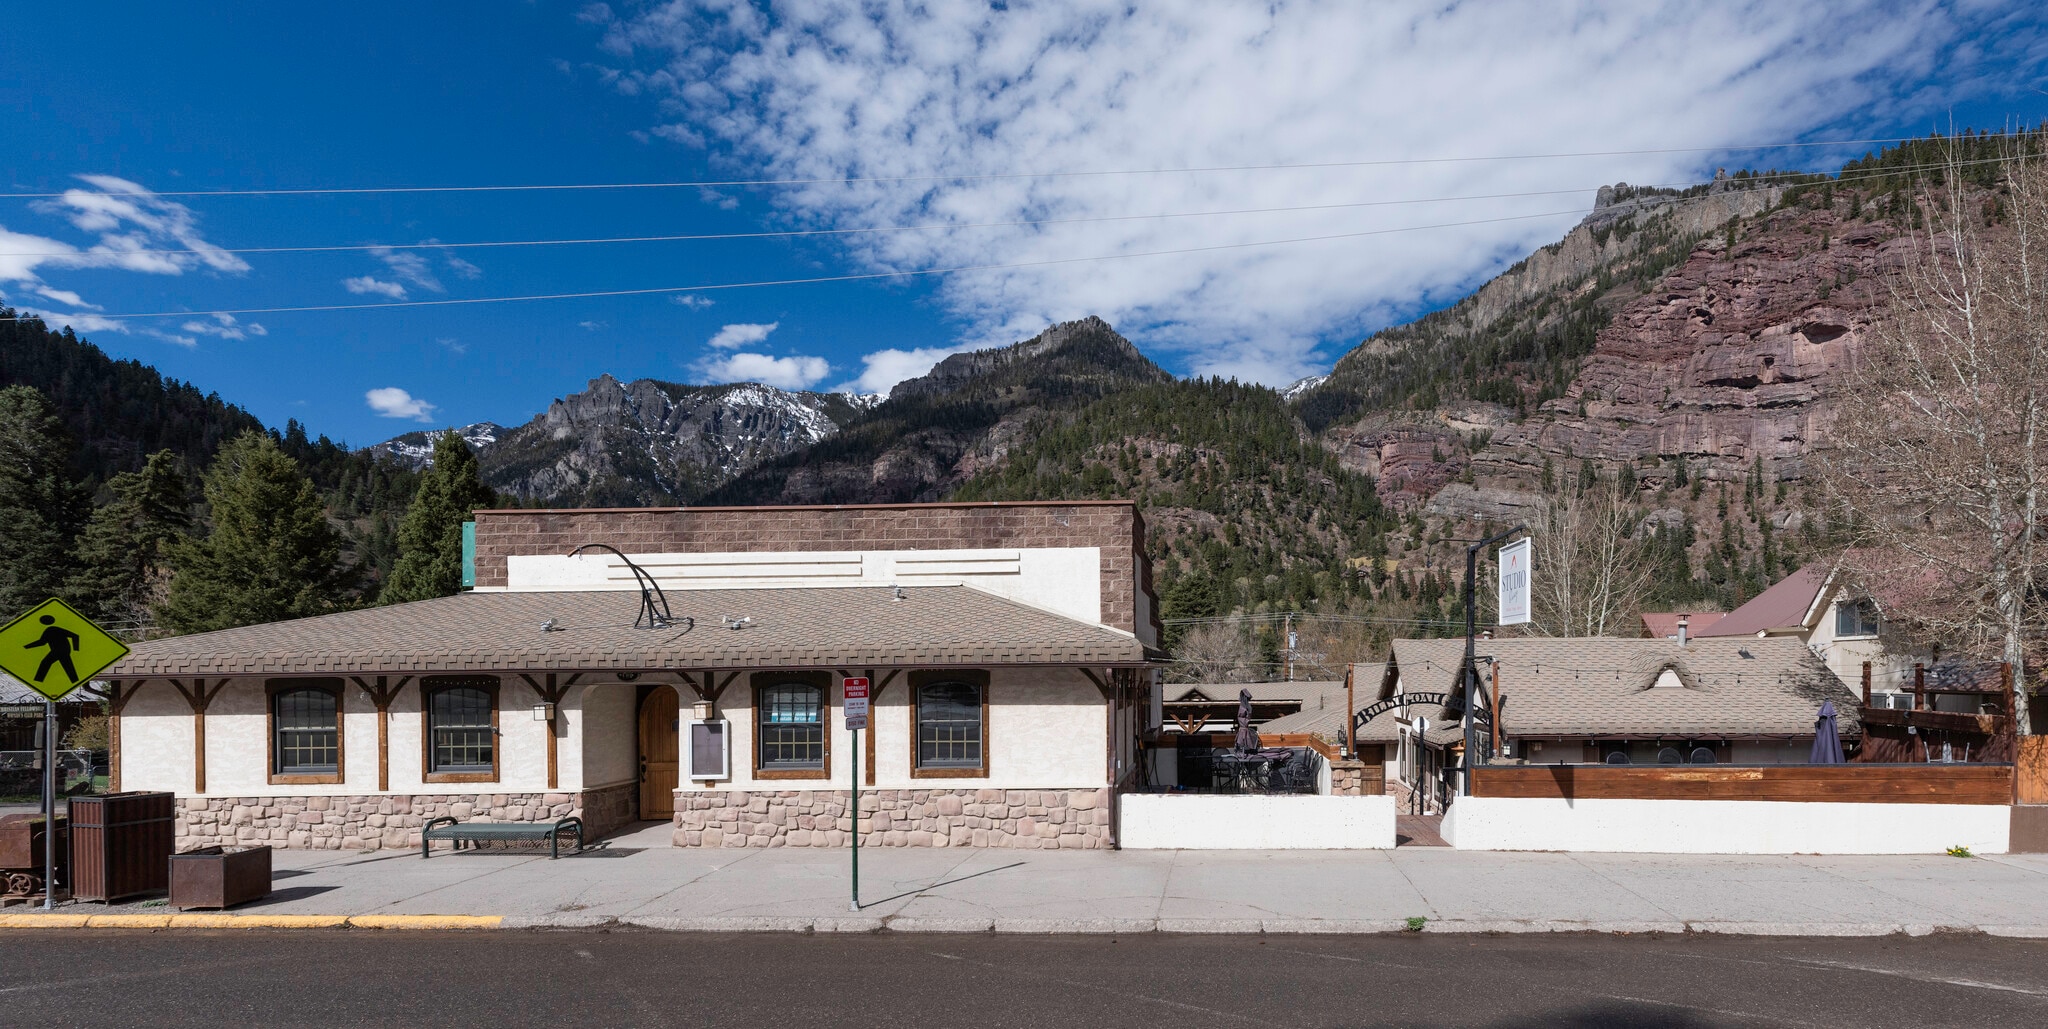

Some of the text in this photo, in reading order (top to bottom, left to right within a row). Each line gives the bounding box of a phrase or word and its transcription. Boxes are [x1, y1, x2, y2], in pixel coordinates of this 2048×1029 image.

[1502, 570, 1526, 592] STUDIO
[1359, 692, 1439, 724] BILLY GOAT
